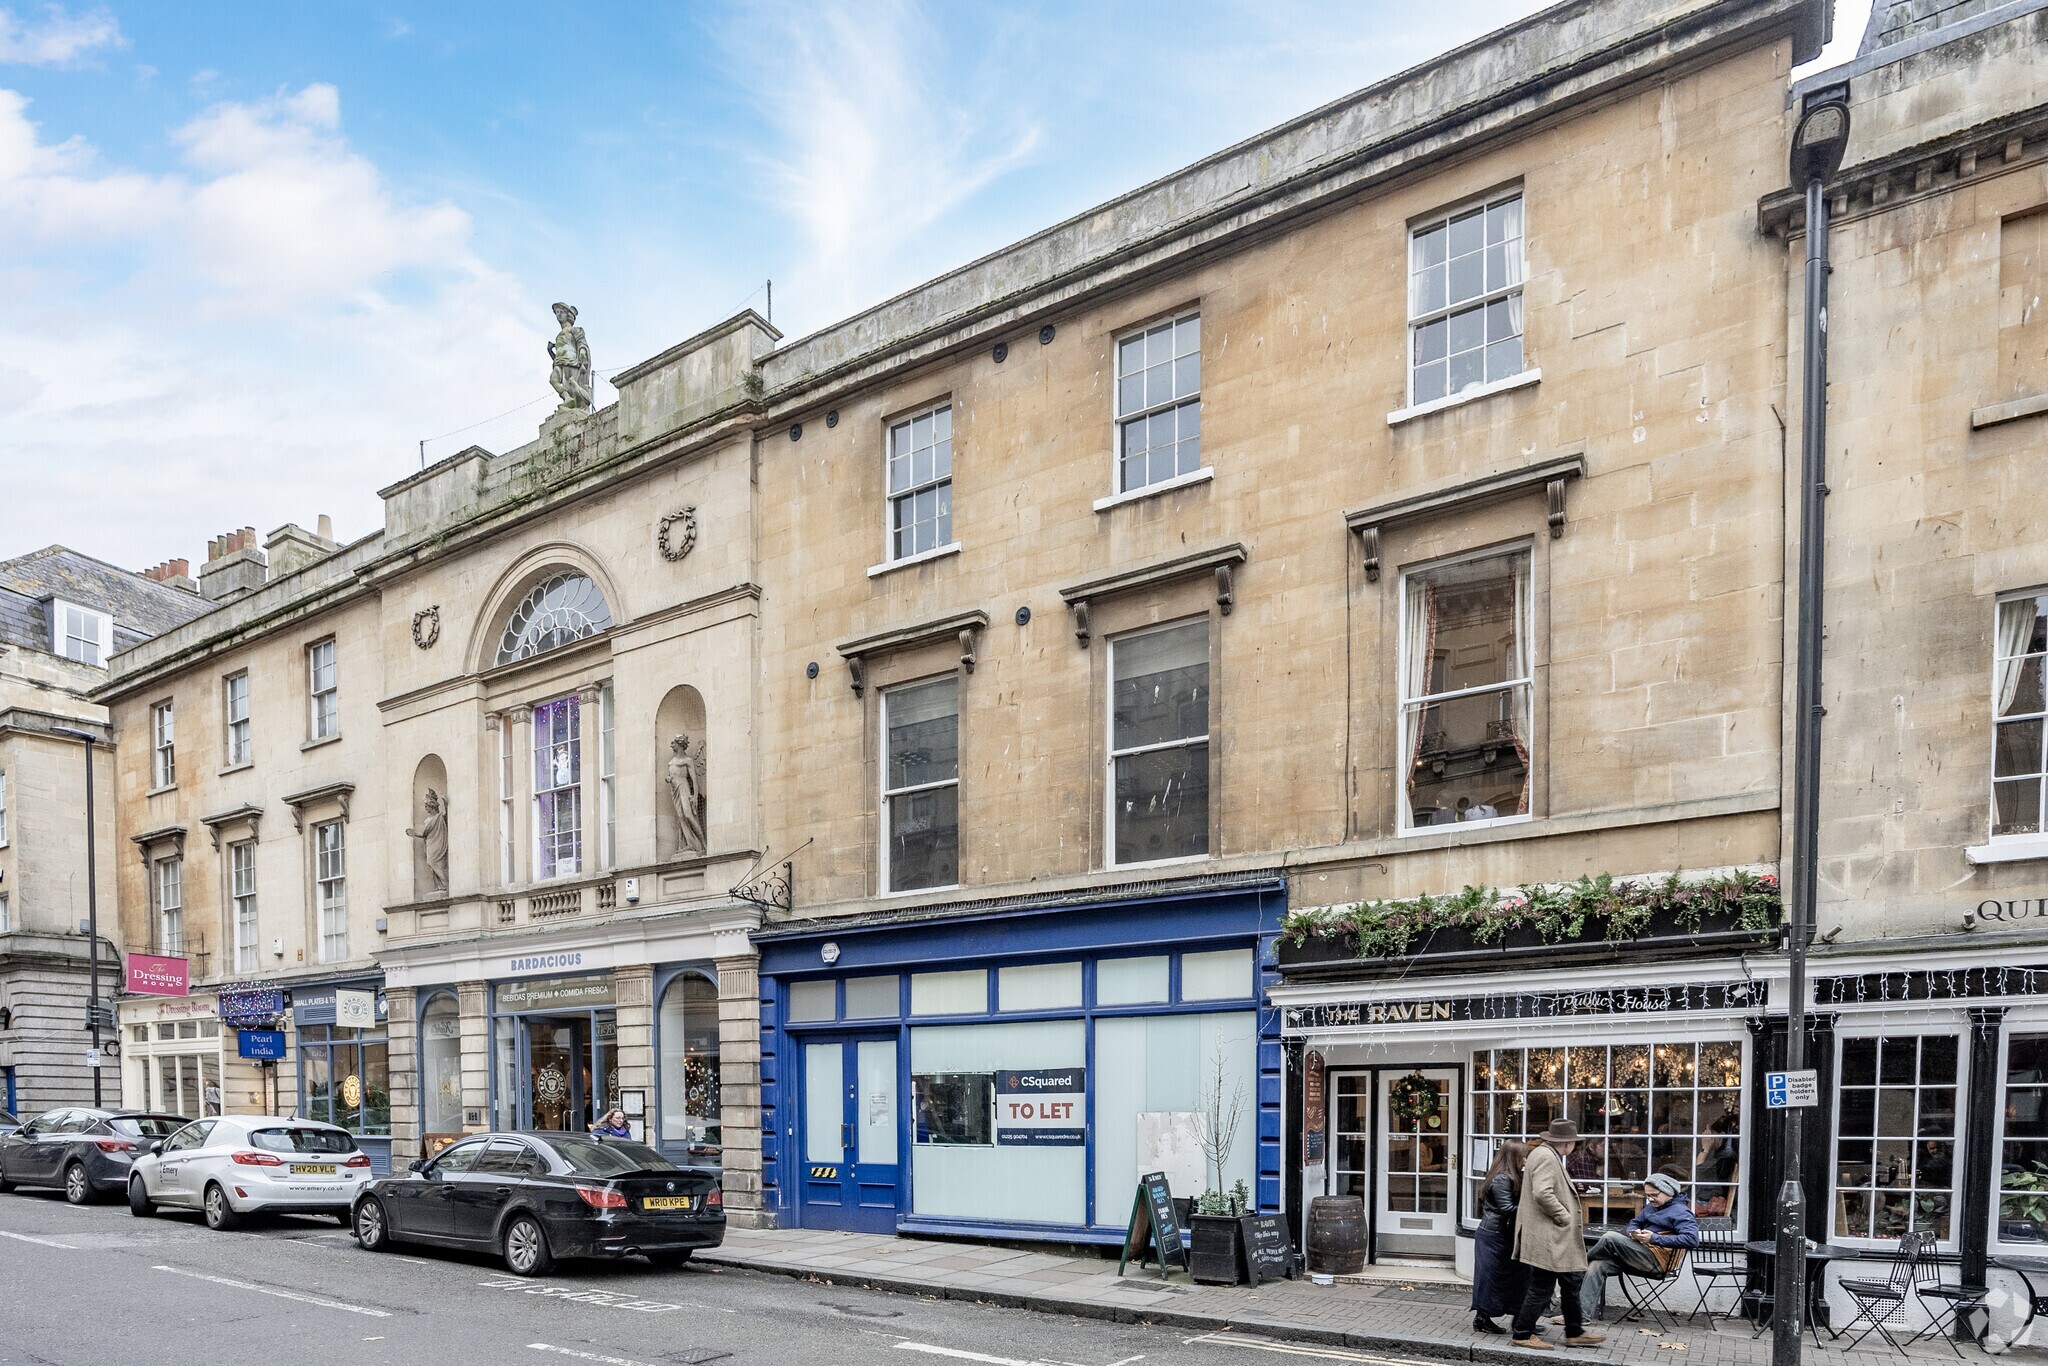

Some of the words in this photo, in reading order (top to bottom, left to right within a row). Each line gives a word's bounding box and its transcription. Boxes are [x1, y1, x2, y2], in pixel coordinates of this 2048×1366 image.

[511, 953, 581, 971] BARDACIOUS
[133, 969, 183, 986] Dressing
[502, 993, 525, 1002] BEBIDAS
[526, 990, 553, 1000] PREMIUM
[560, 988, 583, 997] COMIDA
[584, 985, 608, 994] FRESCA
[165, 1003, 191, 1017] Dressing
[191, 1001, 210, 1012] Room
[294, 998, 308, 1007] SMALL
[308, 996, 325, 1006] PLATES
[1616, 993, 1671, 1010] House
[1328, 1009, 1360, 1021] THE
[1369, 1002, 1451, 1022] RAVEN
[251, 1035, 273, 1043] Pearl
[251, 1047, 274, 1055] India
[1021, 1075, 1072, 1089] CSquared
[1008, 1103, 1035, 1119] TO
[1040, 1103, 1073, 1119] LET
[163, 1165, 178, 1176] Emery
[295, 1165, 318, 1173] HV20
[319, 1165, 336, 1173] VLG
[649, 1198, 668, 1207] WR10
[669, 1197, 685, 1206] KPE
